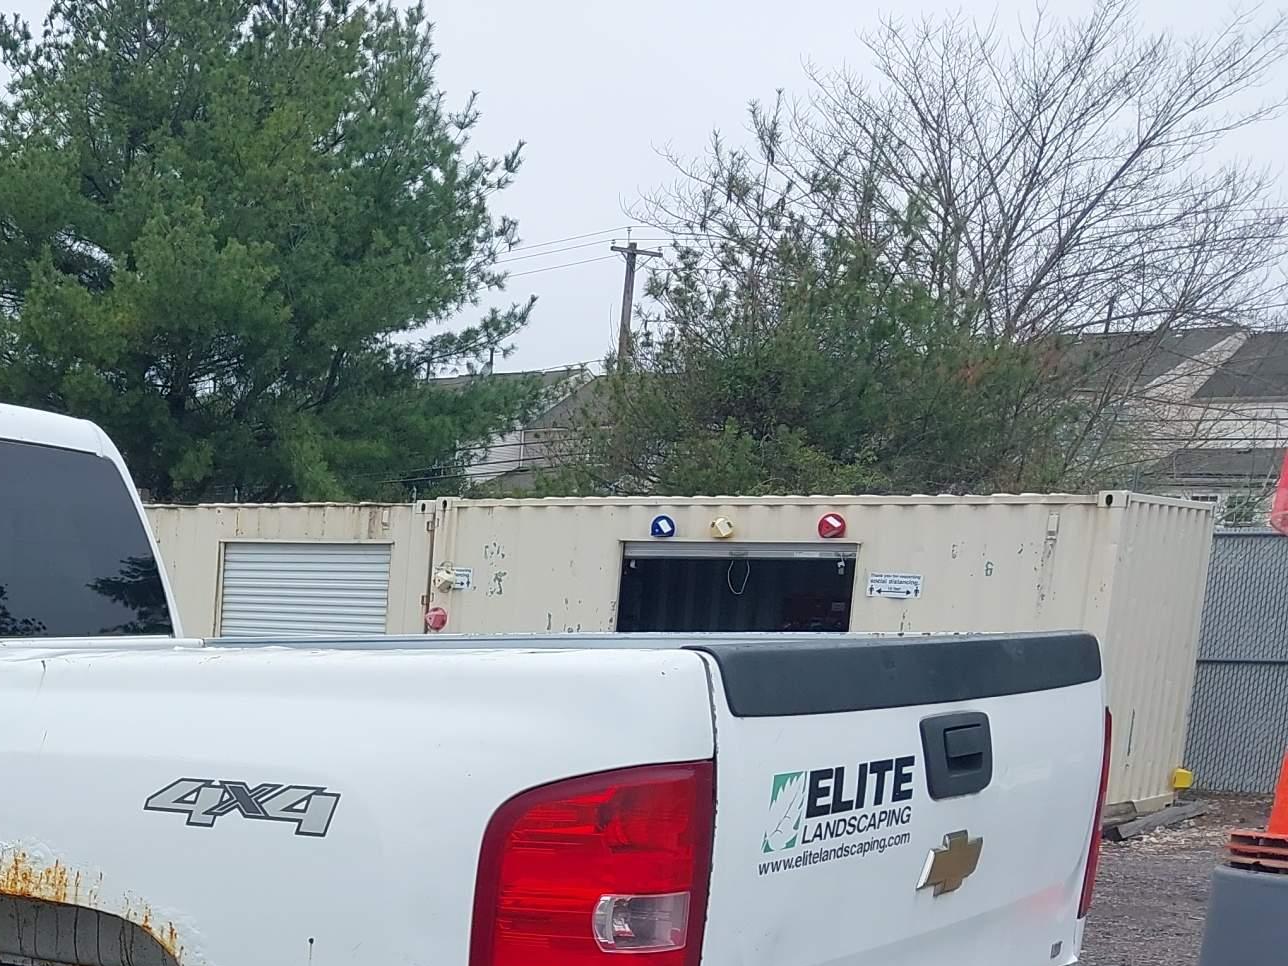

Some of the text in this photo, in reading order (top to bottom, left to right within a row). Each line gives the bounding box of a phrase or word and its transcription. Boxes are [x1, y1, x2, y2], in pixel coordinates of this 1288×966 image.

[805, 755, 916, 819] ELITE
[801, 805, 912, 845] LANDSCAPING
[758, 832, 911, 876] www.elitelandscaping.com
